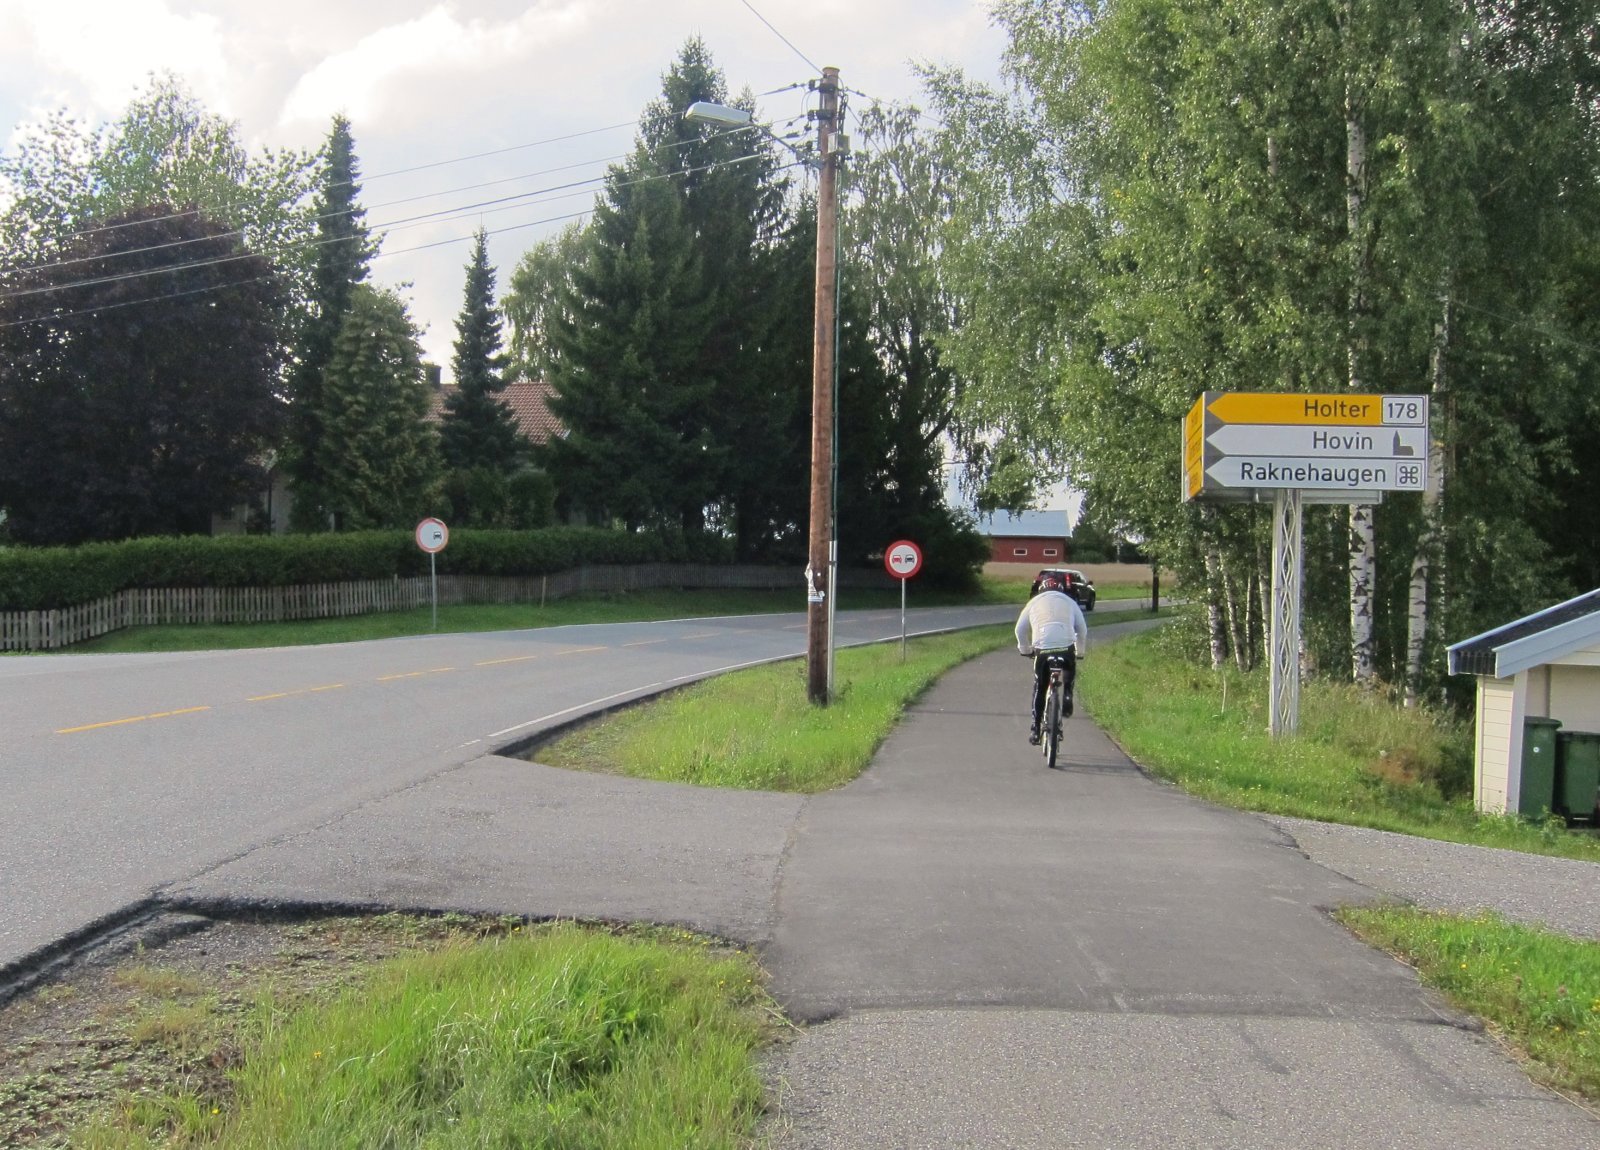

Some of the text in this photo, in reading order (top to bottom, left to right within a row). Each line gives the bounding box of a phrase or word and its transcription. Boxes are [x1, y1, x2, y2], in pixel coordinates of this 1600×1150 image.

[1304, 399, 1418, 419] Holter 178
[1312, 431, 1373, 450] Hovin
[1240, 462, 1386, 486] Raknehaugen
